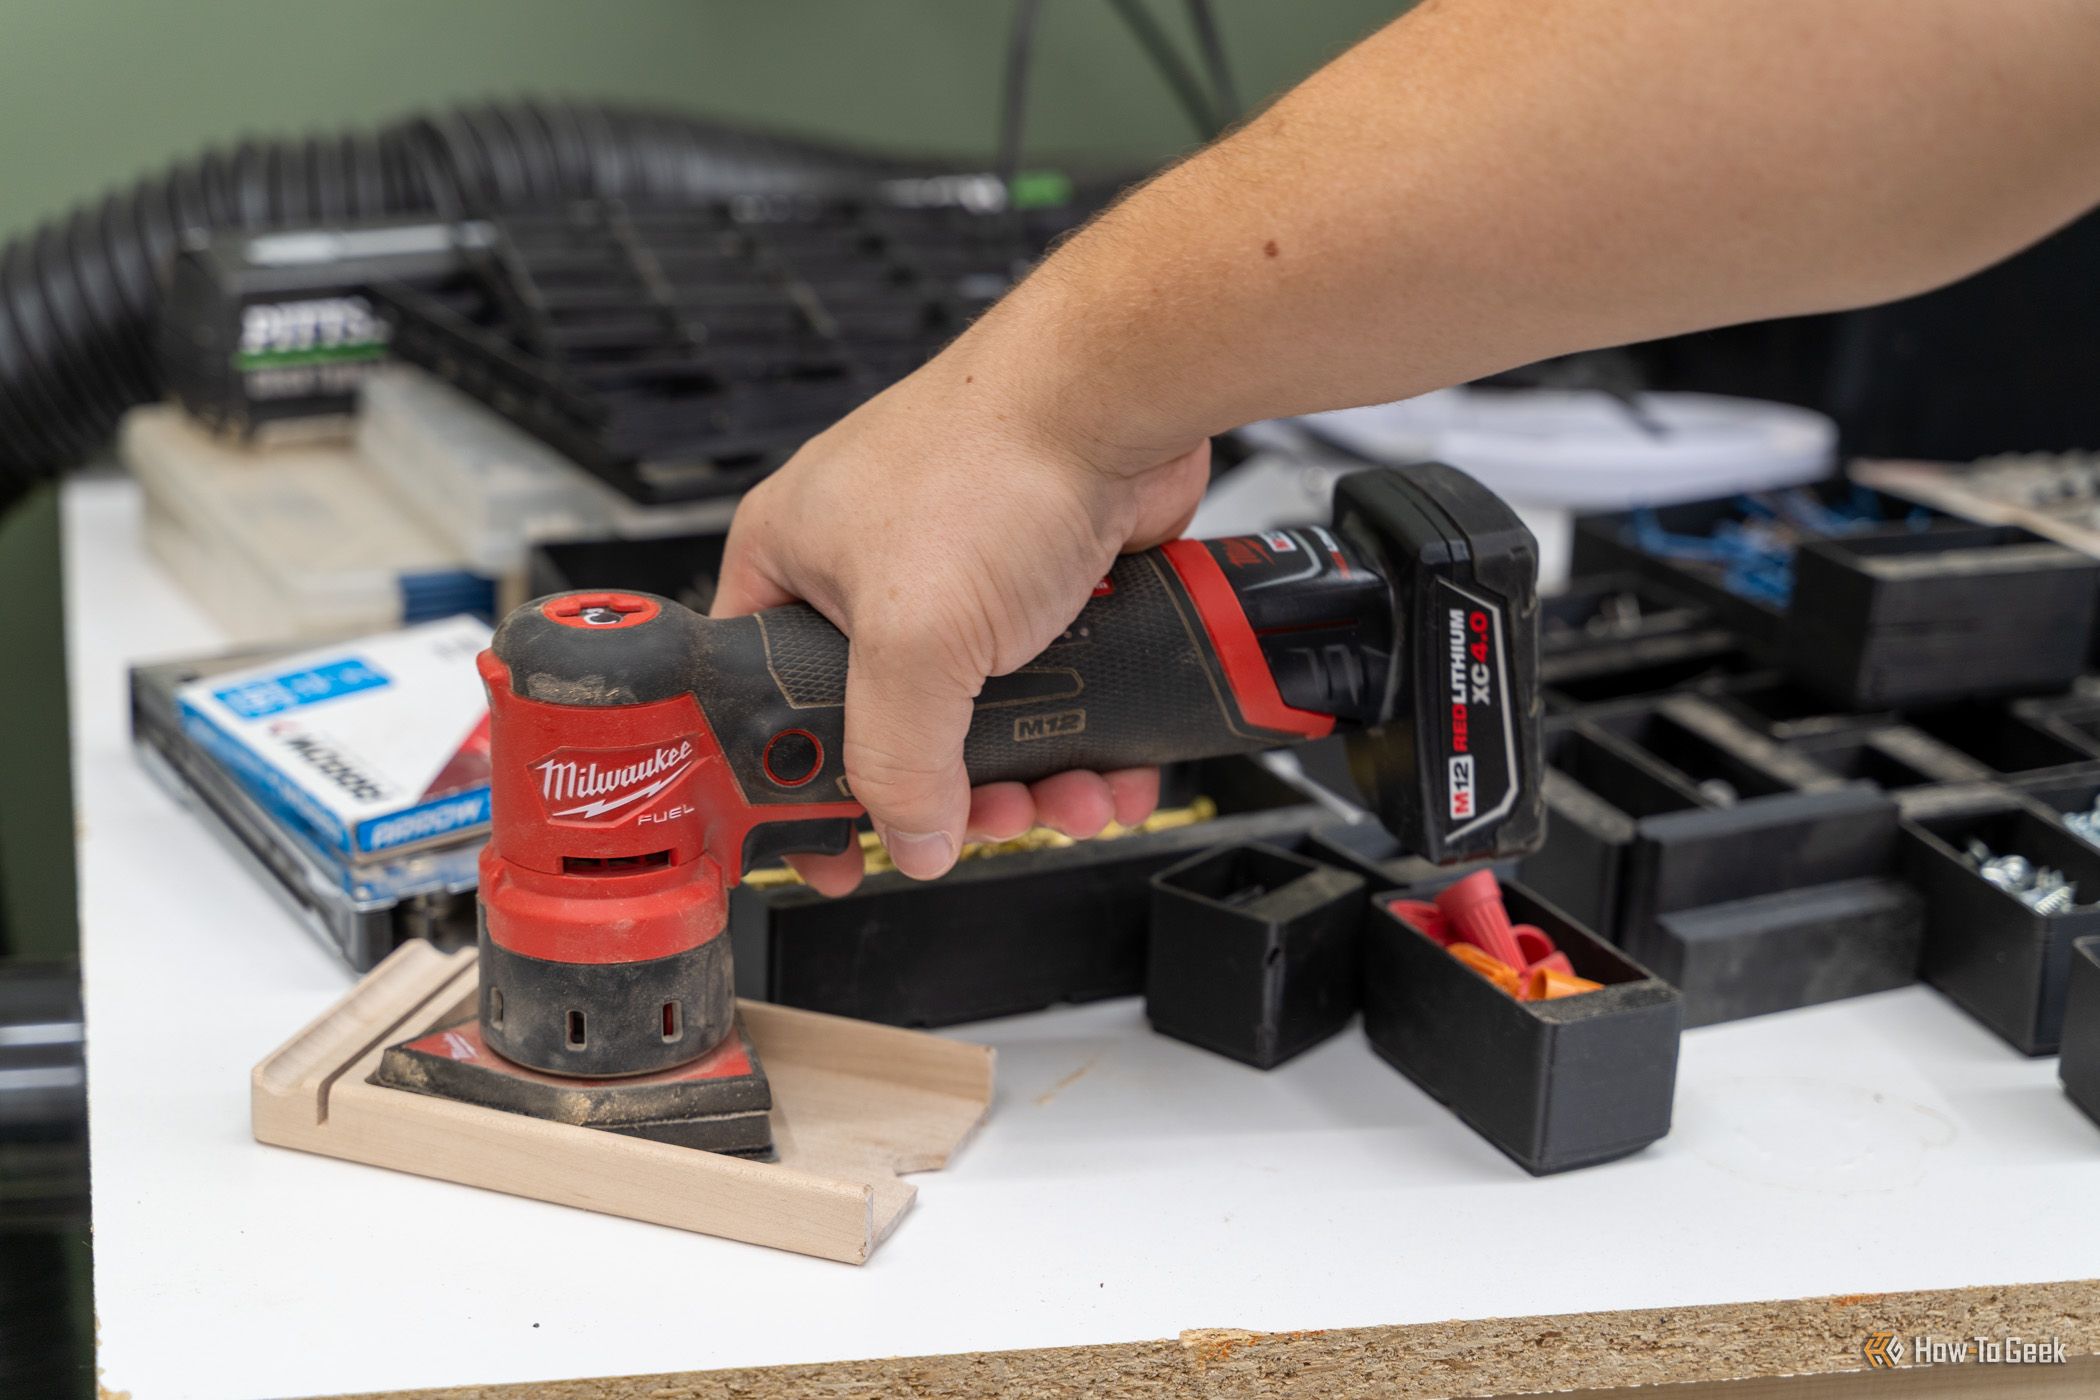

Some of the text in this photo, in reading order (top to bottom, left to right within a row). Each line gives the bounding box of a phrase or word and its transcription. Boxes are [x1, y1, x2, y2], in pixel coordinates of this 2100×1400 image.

[1020, 714, 1081, 737] M12
[537, 740, 693, 799] Milwaukee
[1453, 761, 1470, 815] M12
[637, 804, 695, 825] FUEL
